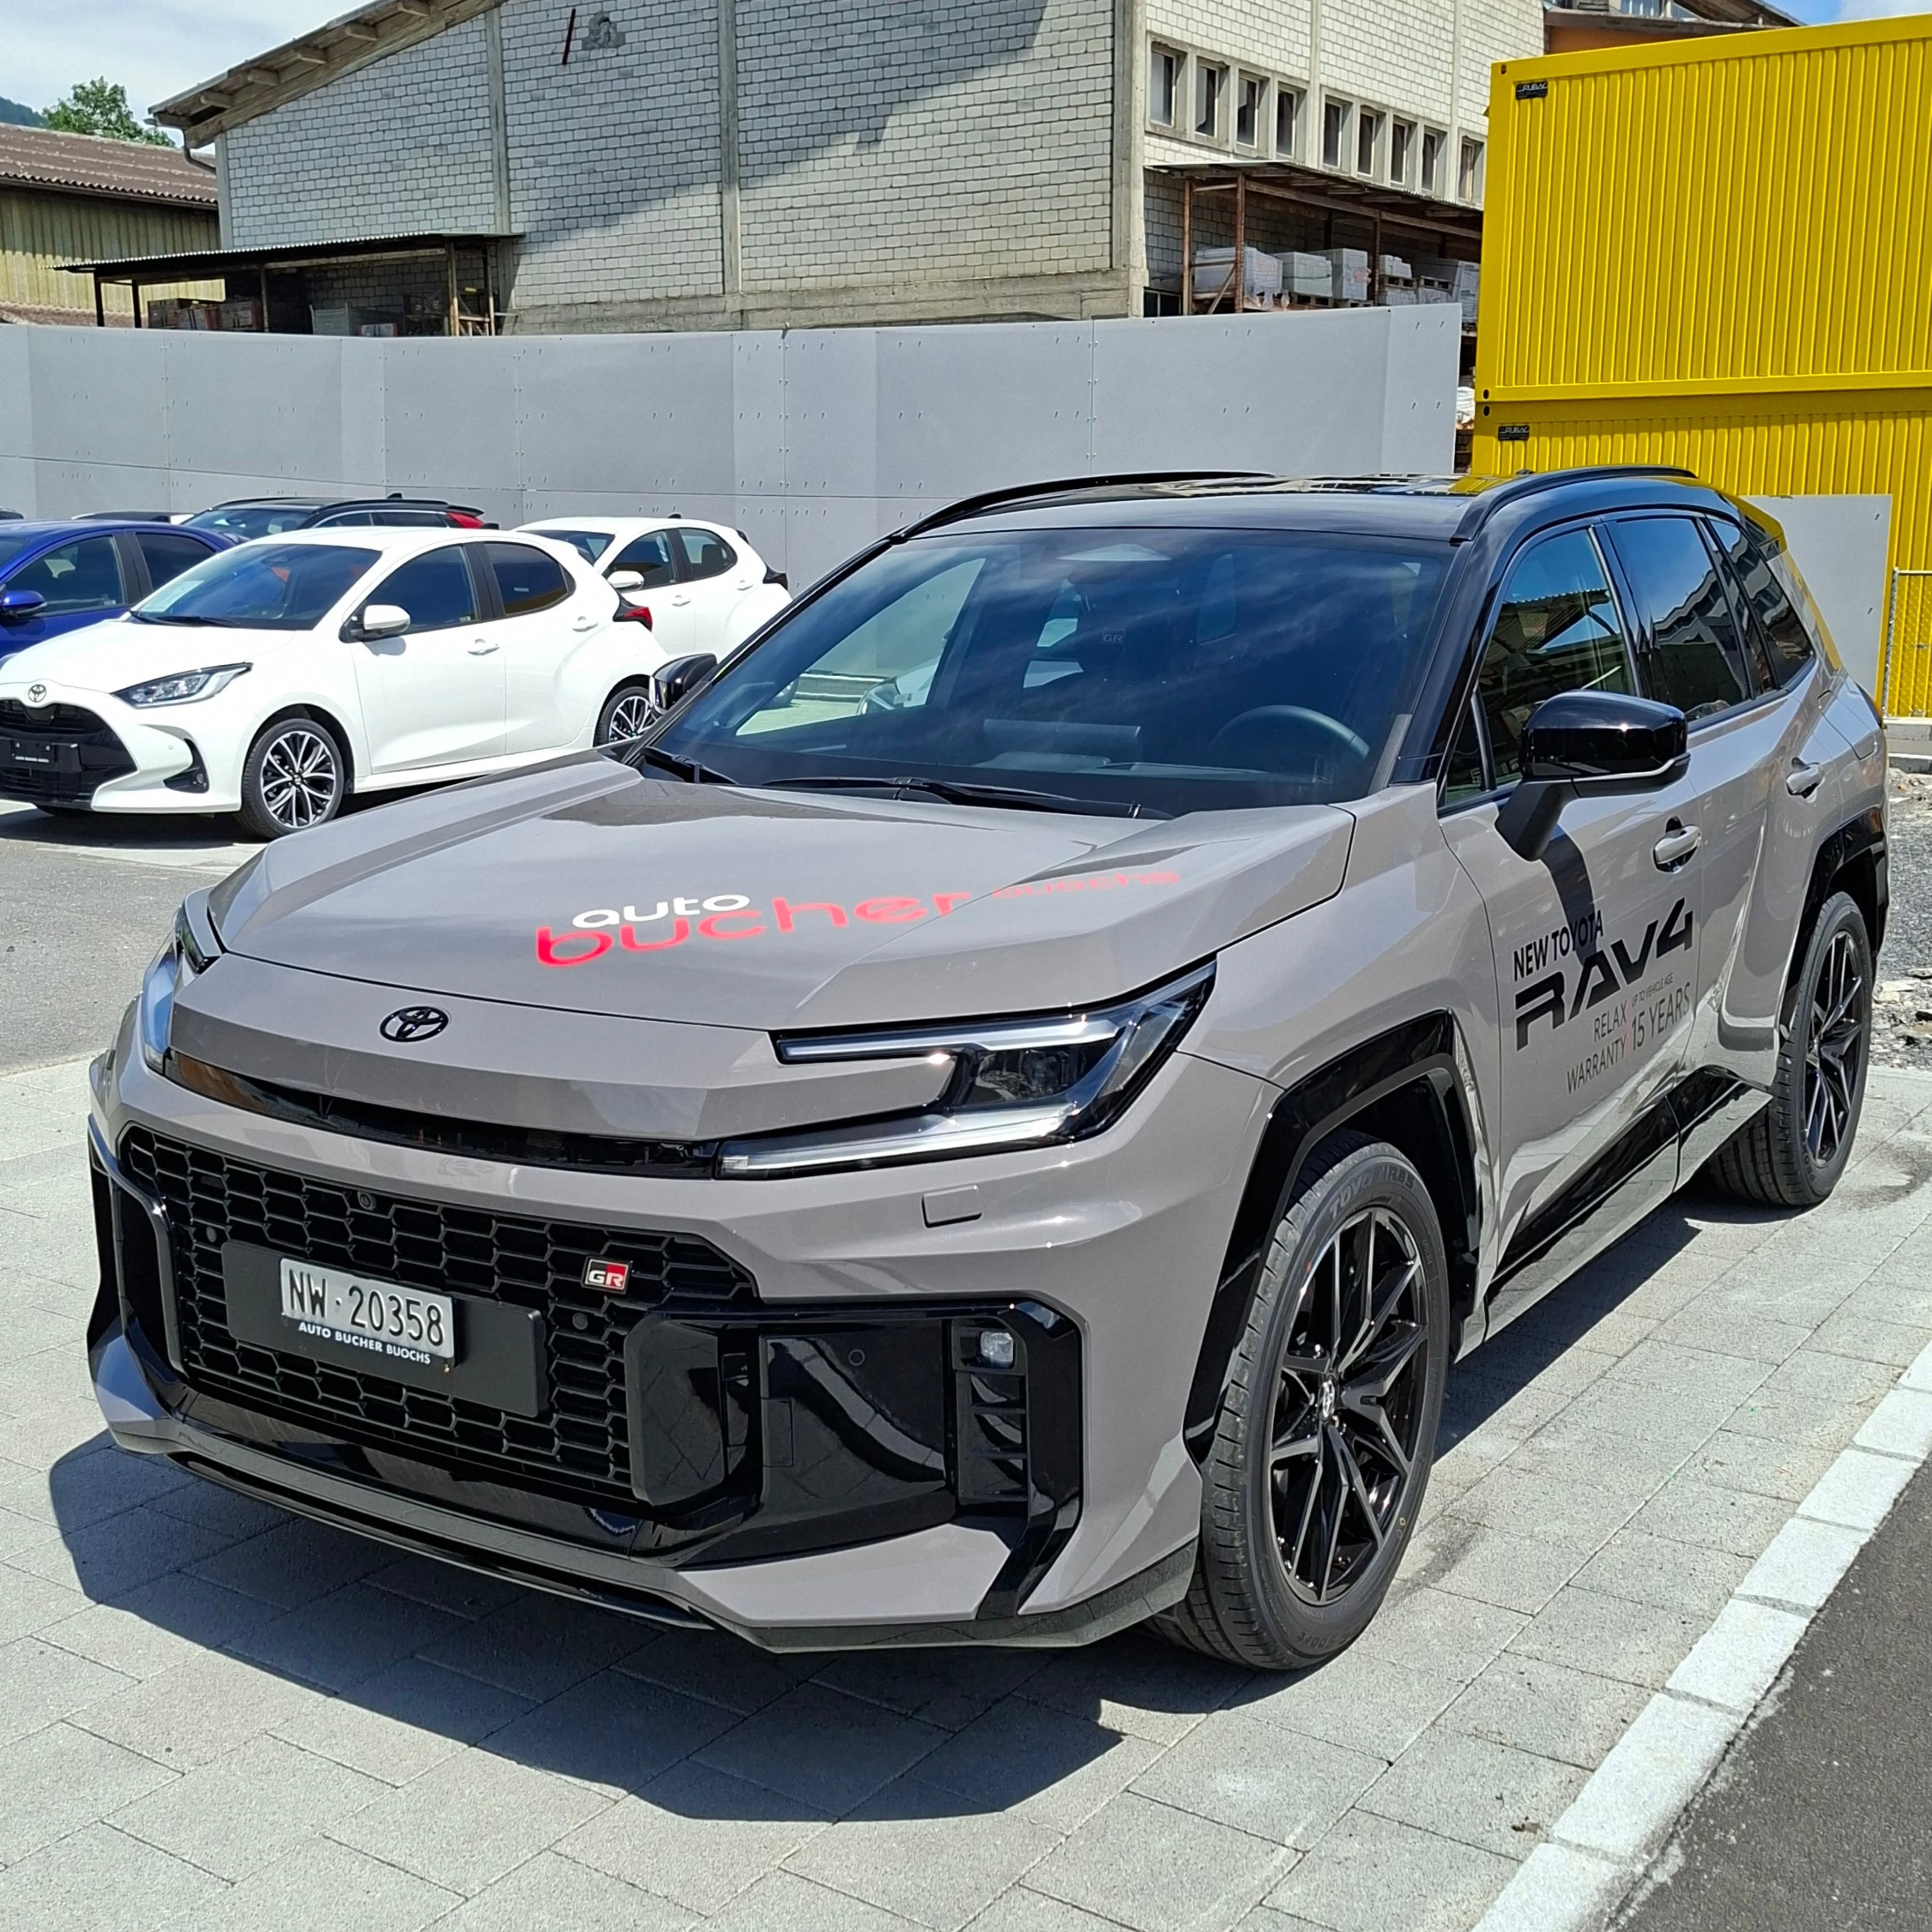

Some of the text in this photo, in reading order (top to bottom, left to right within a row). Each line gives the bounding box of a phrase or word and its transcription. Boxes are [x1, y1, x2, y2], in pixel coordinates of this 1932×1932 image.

[536, 891, 971, 967] bucher
[573, 894, 750, 928] auto
[1514, 909, 1604, 982] NEW TOYOTA
[1515, 897, 1693, 1051] RAV4
[1631, 994, 1638, 1007] UP
[1646, 978, 1663, 998] VEHICLE
[1664, 972, 1674, 985] AGE
[1594, 1000, 1627, 1043] RELAX
[1631, 981, 1690, 1051] 15 YEARS
[1567, 1034, 1627, 1094] WARRANTY
[1329, 1169, 1374, 1220] TOYO
[588, 1269, 624, 1287] GR
[290, 1269, 444, 1347] NW 20358
[298, 1322, 431, 1364] AUTO BUCHER BUOCHS
